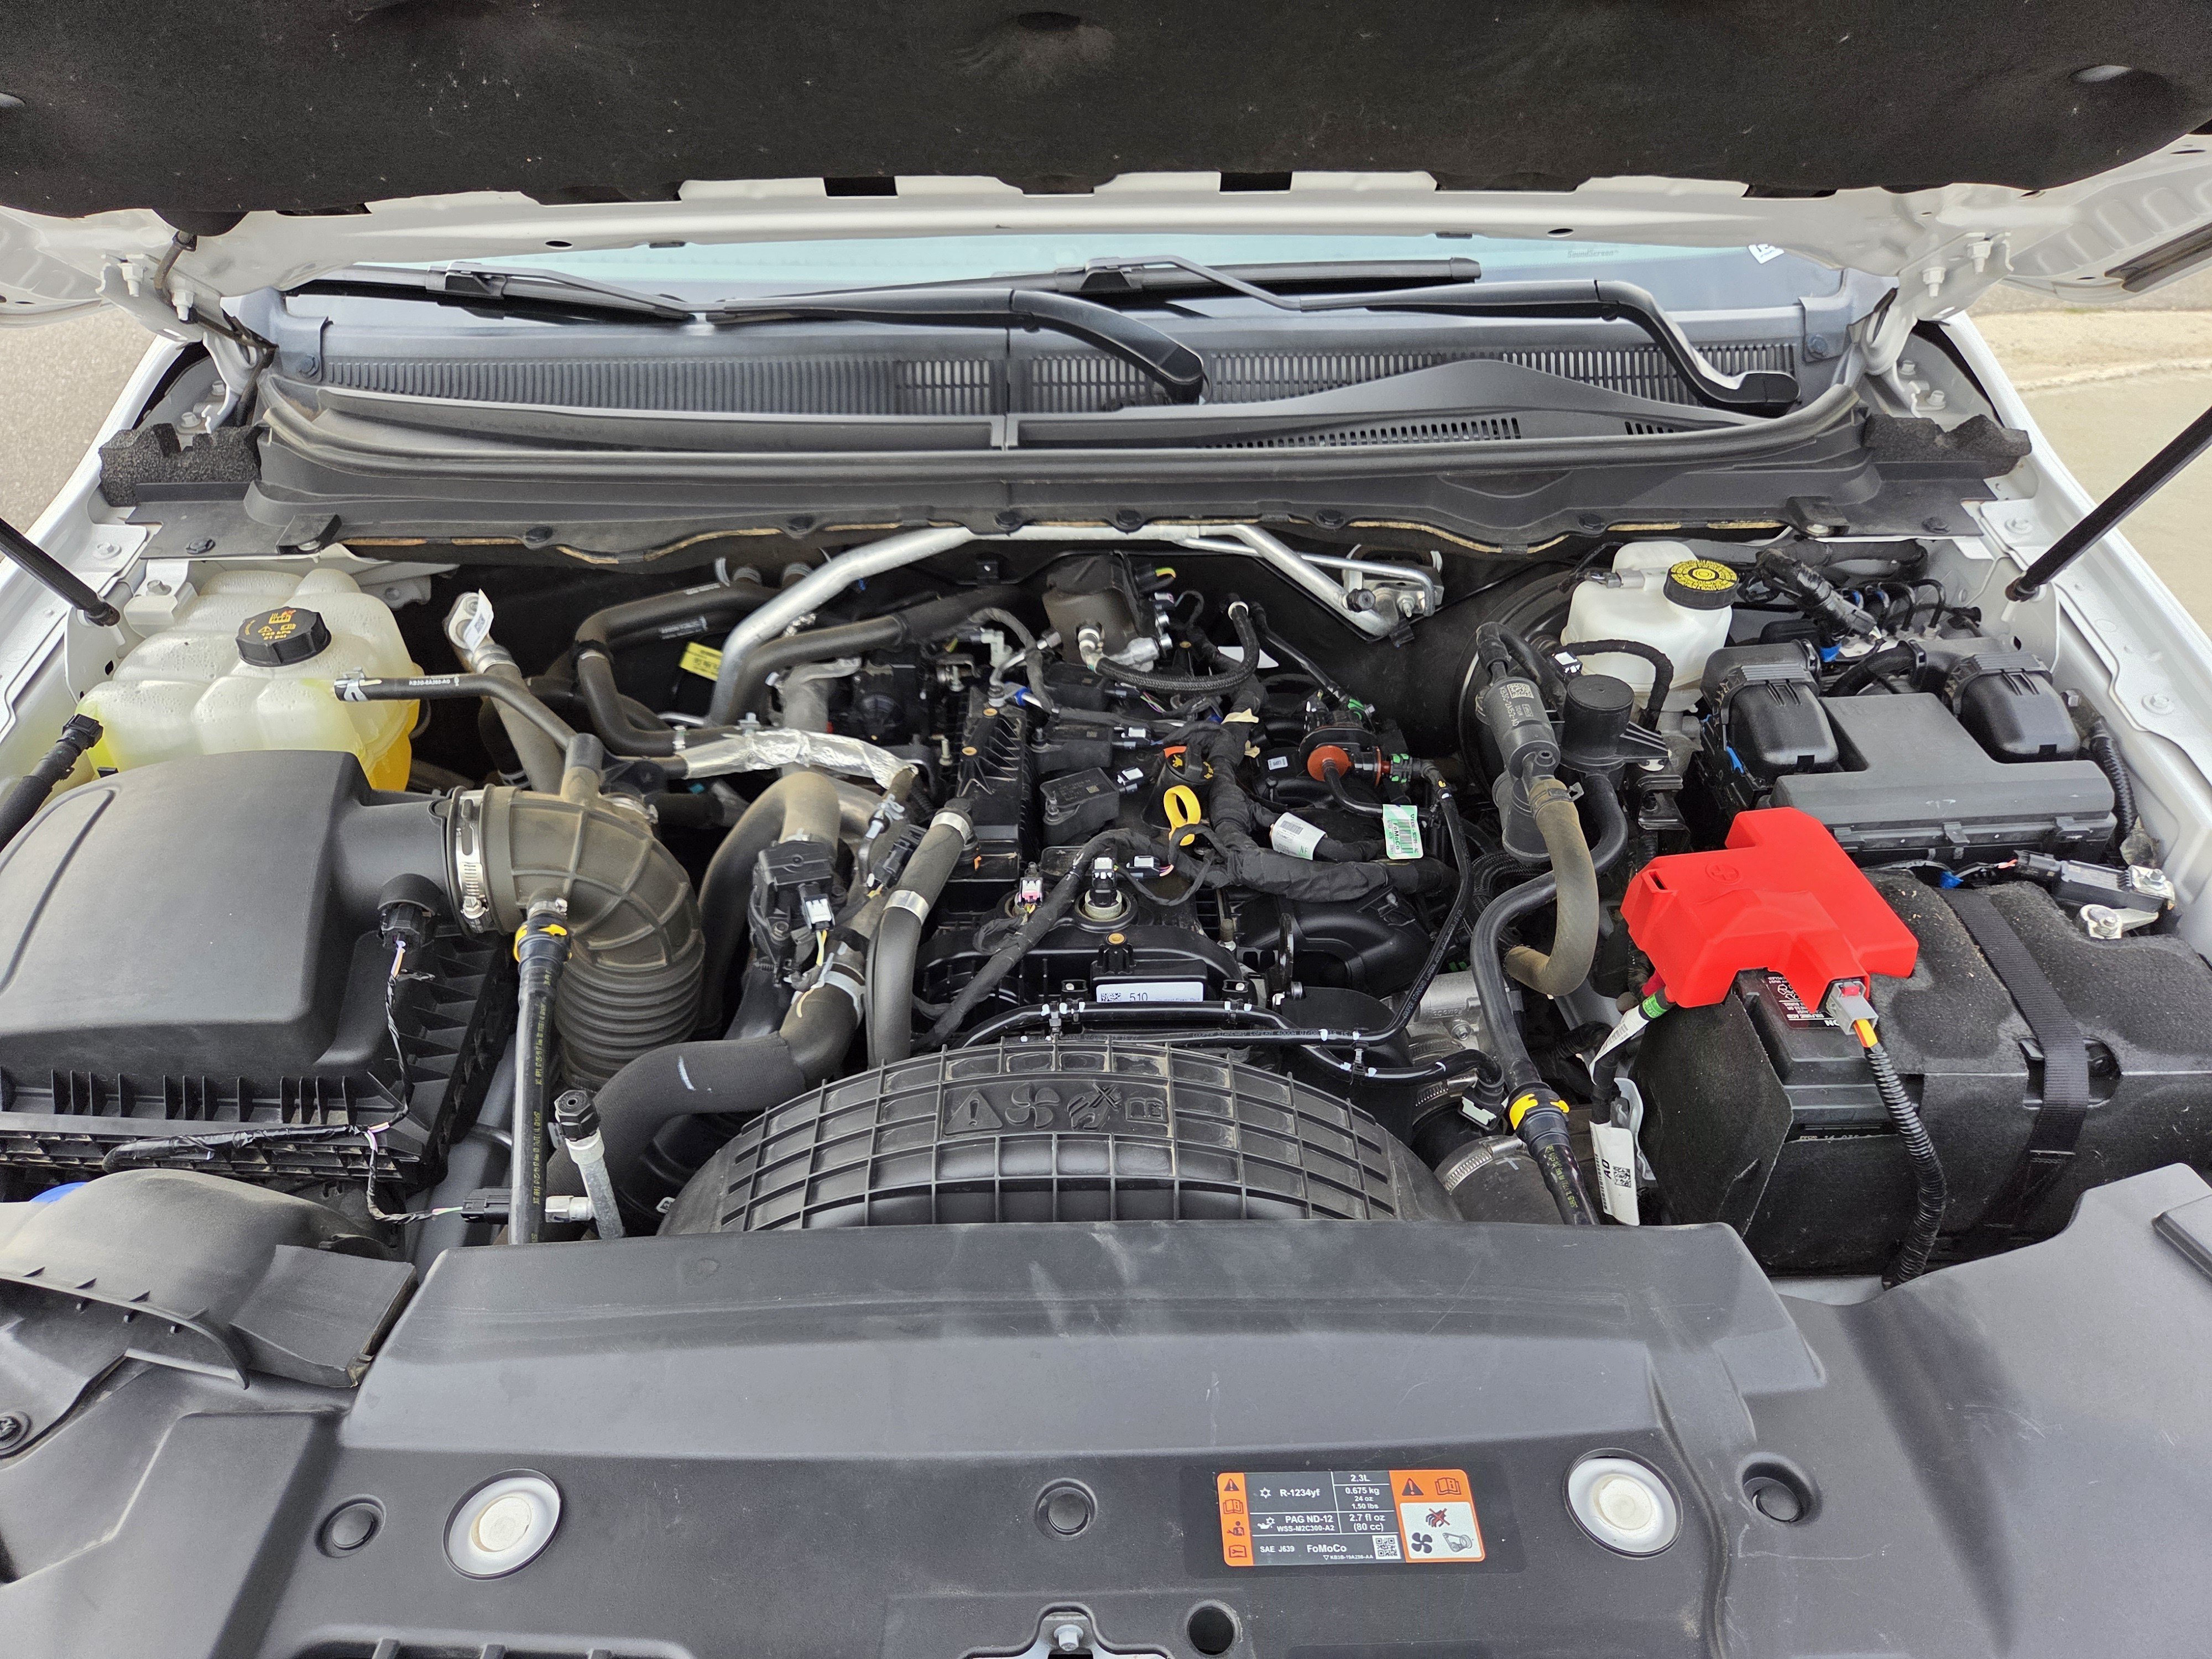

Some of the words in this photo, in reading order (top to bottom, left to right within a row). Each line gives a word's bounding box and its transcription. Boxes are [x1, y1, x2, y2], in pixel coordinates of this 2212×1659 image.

[1129, 992, 1148, 1001] 510
[1350, 1474, 1371, 1482] 2.3L
[1280, 1488, 1321, 1498] R-1234yf
[1369, 1486, 1380, 1496] kg
[1285, 1515, 1305, 1524] PAG
[1306, 1515, 1334, 1523] ND-12
[1349, 1514, 1363, 1522] 2.7
[1365, 1513, 1372, 1521] fl
[1353, 1522, 1368, 1532] (80
[1369, 1522, 1384, 1532] cc)
[1306, 1543, 1347, 1553] FoMoCo
